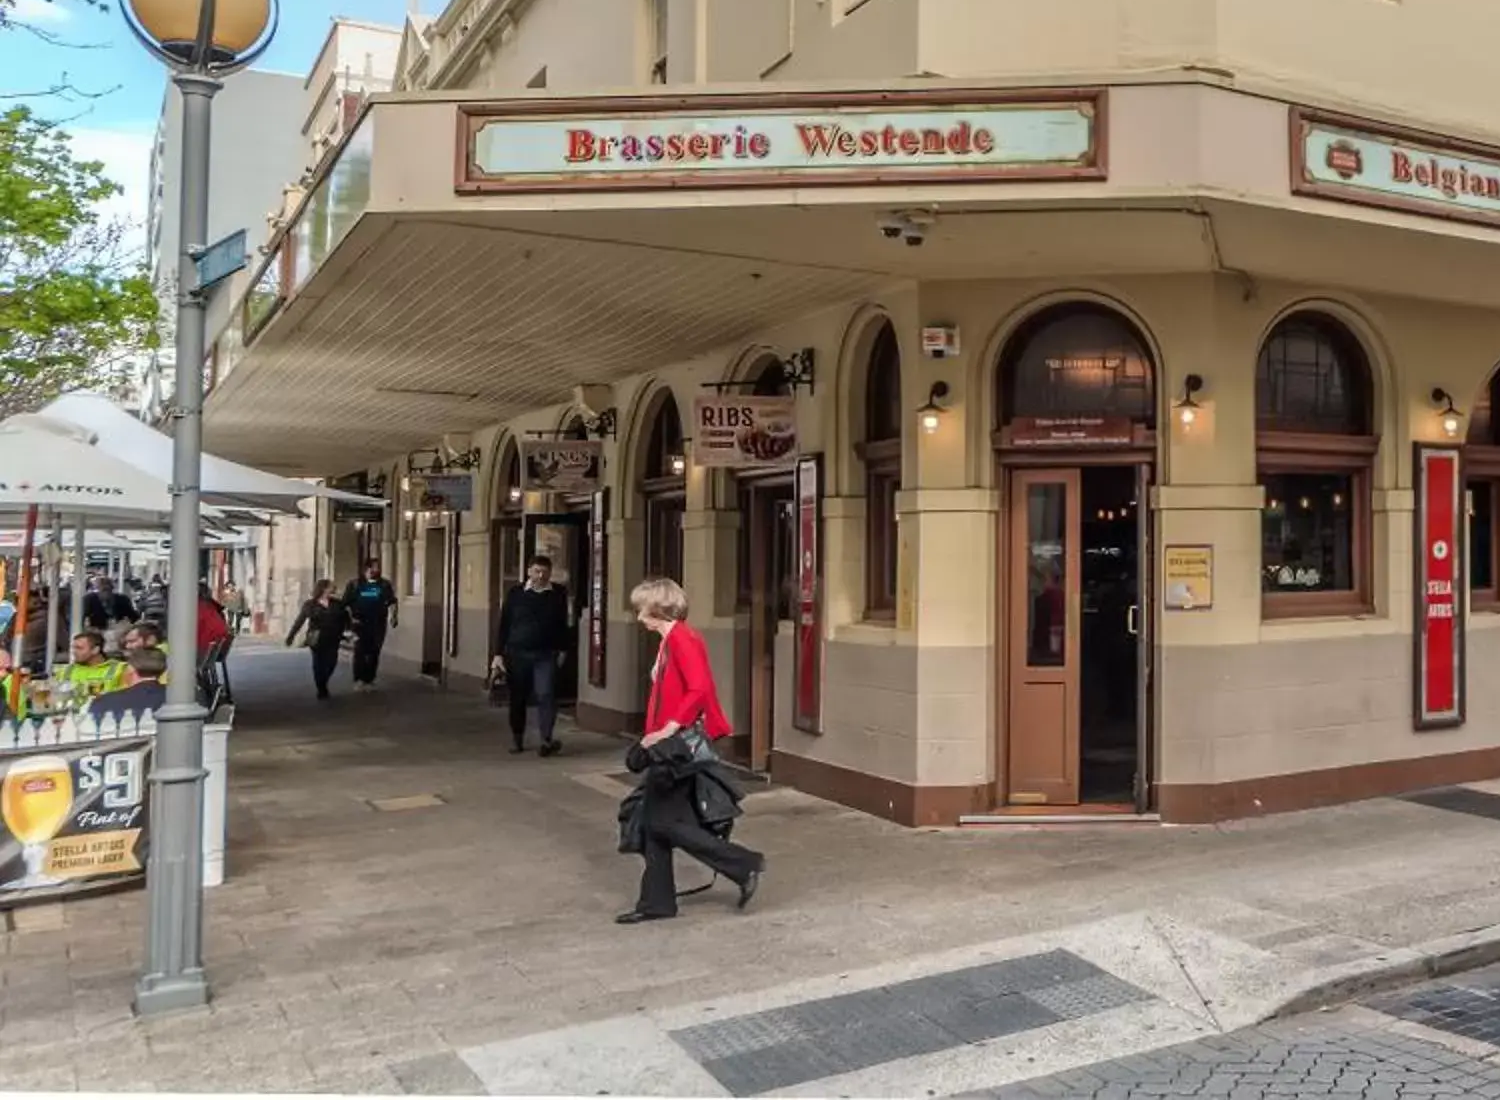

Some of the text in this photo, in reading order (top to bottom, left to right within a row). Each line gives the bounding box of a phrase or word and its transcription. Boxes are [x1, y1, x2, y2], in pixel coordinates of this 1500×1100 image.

[564, 120, 995, 164] Brasserie Westende
[702, 406, 754, 427] RIBS
[79, 750, 143, 808] $9
[77, 806, 142, 827] Pint of
